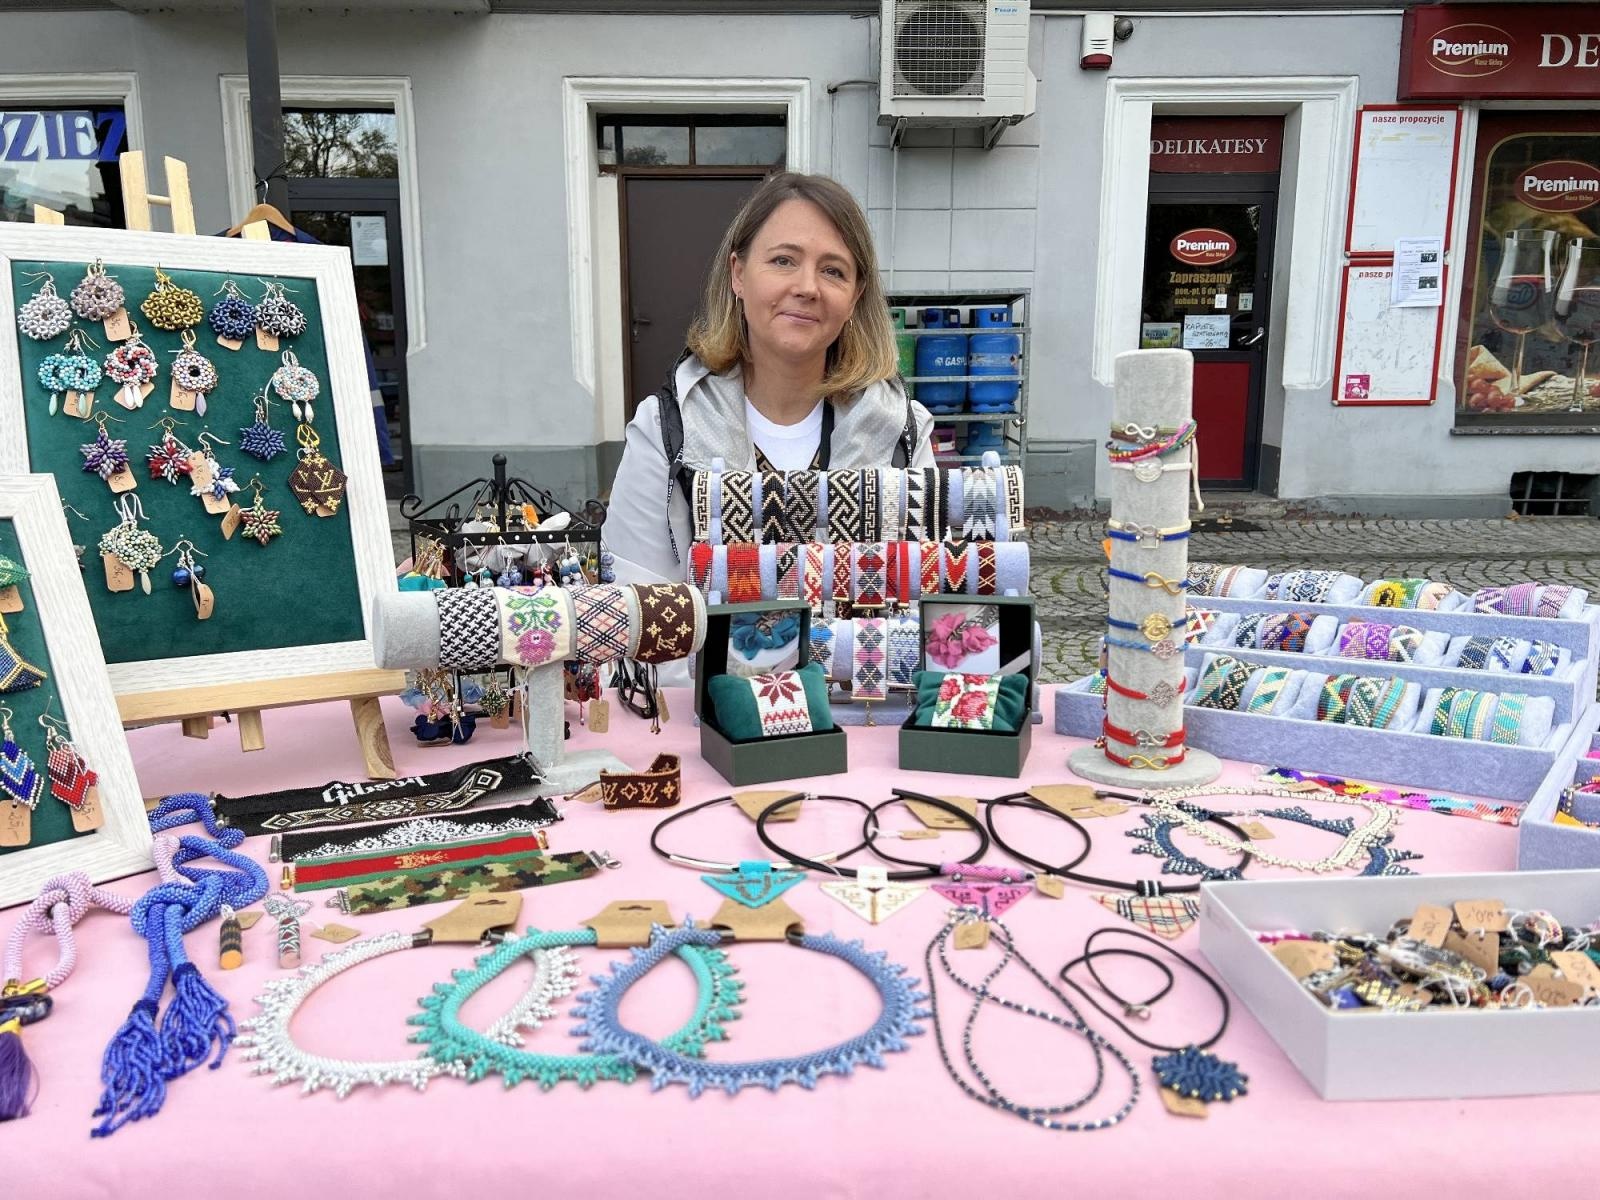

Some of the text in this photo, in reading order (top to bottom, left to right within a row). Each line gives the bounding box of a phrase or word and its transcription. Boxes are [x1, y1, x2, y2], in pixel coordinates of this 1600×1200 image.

[1432, 39, 1508, 56] Premium
[1537, 33, 1600, 68] DE
[1372, 114, 1445, 124] nasze propozycje
[1150, 138, 1269, 155] DELIKATESY
[1523, 175, 1599, 192] Premium
[1177, 239, 1230, 251] Premium
[1169, 271, 1233, 285] Zapraszamy
